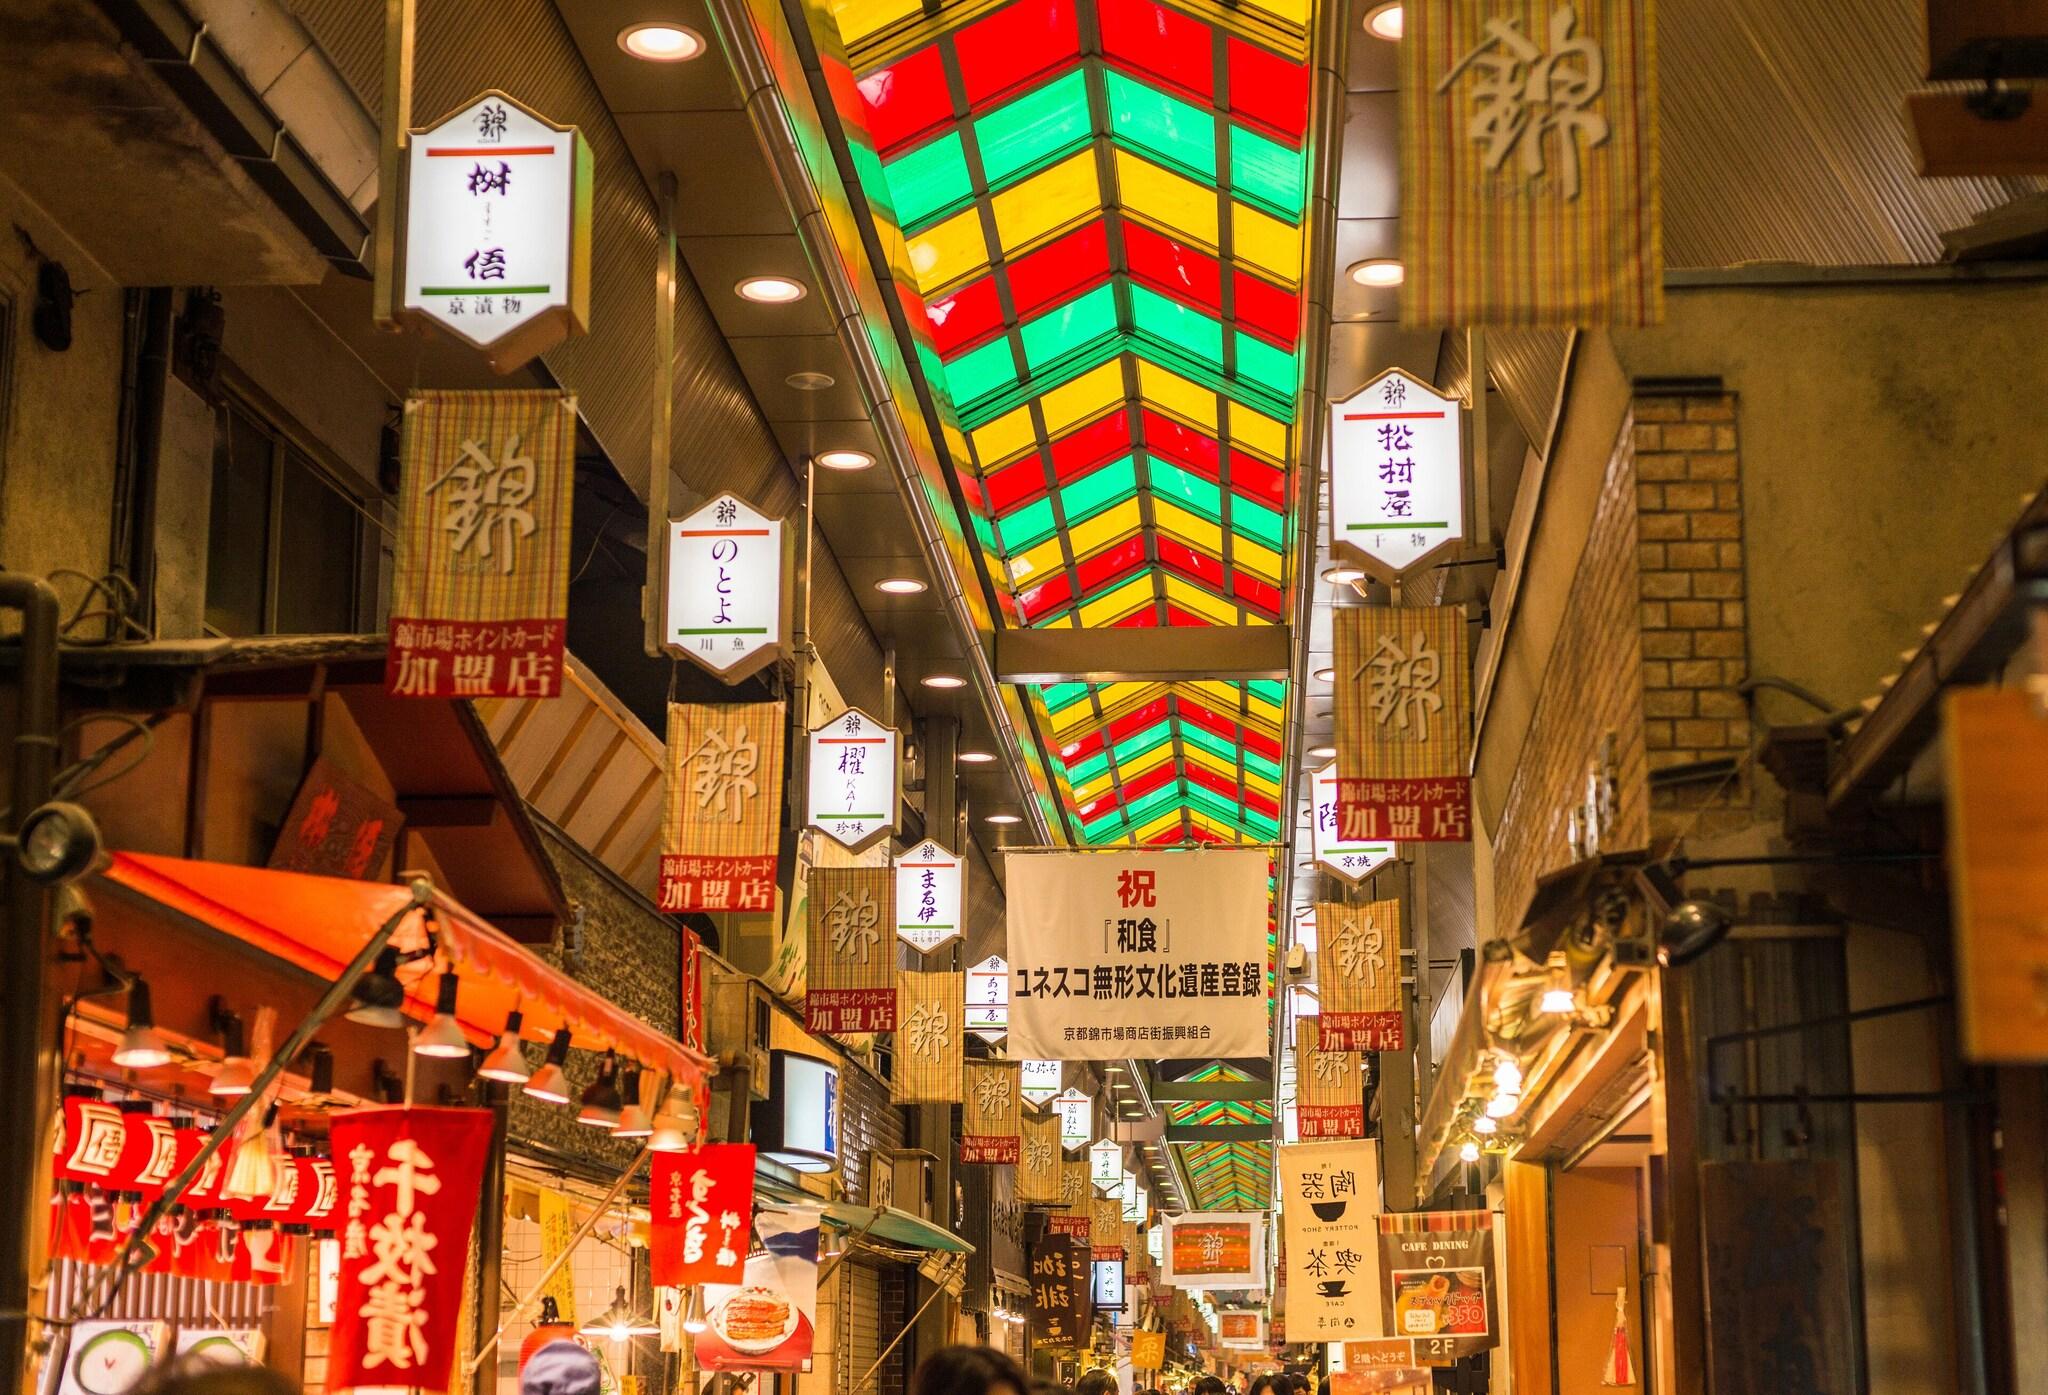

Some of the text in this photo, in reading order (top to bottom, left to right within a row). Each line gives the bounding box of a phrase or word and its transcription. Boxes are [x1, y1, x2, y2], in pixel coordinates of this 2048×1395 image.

[1436, 3, 1609, 202] 錦
[473, 104, 507, 143] 錦
[448, 297, 521, 315] 京漬物
[1379, 379, 1406, 409] 錦
[1377, 423, 1416, 518] 松村屋
[426, 433, 537, 576] 錦
[712, 499, 736, 527] 錦
[712, 539, 738, 624] のとよ
[394, 622, 557, 651] 錦市場ポイントカード
[392, 651, 554, 696] 加盟店
[1352, 629, 1443, 743] 錦
[843, 715, 861, 736] 錦
[681, 725, 759, 824] 錦
[1340, 781, 1466, 802] 錦市場ポイントカード
[836, 821, 864, 835] 珍味
[1341, 803, 1466, 839] 加盟店
[920, 844, 935, 862] 錦
[1342, 855, 1371, 867] 京焼
[663, 859, 772, 878] 錦市場ポイントカード
[661, 878, 770, 909] 加盟店
[917, 869, 938, 924] まる伊
[1117, 870, 1157, 908] 祝
[820, 887, 880, 965] 錦
[1105, 918, 1170, 953] 『和食』
[1328, 915, 1385, 989] 錦
[1015, 962, 1261, 999] ユネスコ無形文化遺産登録
[810, 991, 894, 1006] 錦市場ポイントカード
[810, 1006, 893, 1031] 加盟店
[900, 1001, 949, 1064] 錦
[1064, 1026, 1211, 1040] 京都錦市場商店街振興組合
[1322, 1014, 1400, 1029] 錦市場ポイントカード
[1322, 1029, 1400, 1050] 加盟店
[972, 1071, 1011, 1121] 錦
[1300, 1106, 1360, 1118] 錦市場ポイントカード
[1301, 1118, 1360, 1135] 加盟店
[964, 1148, 1017, 1163] 加盟店
[1022, 1135, 1052, 1178] 錦
[1098, 1208, 1116, 1234] 錦
[1199, 1231, 1224, 1265] 錦
[1402, 1240, 1469, 1252] CAFE DINING
[1430, 1339, 1454, 1354] 2F
